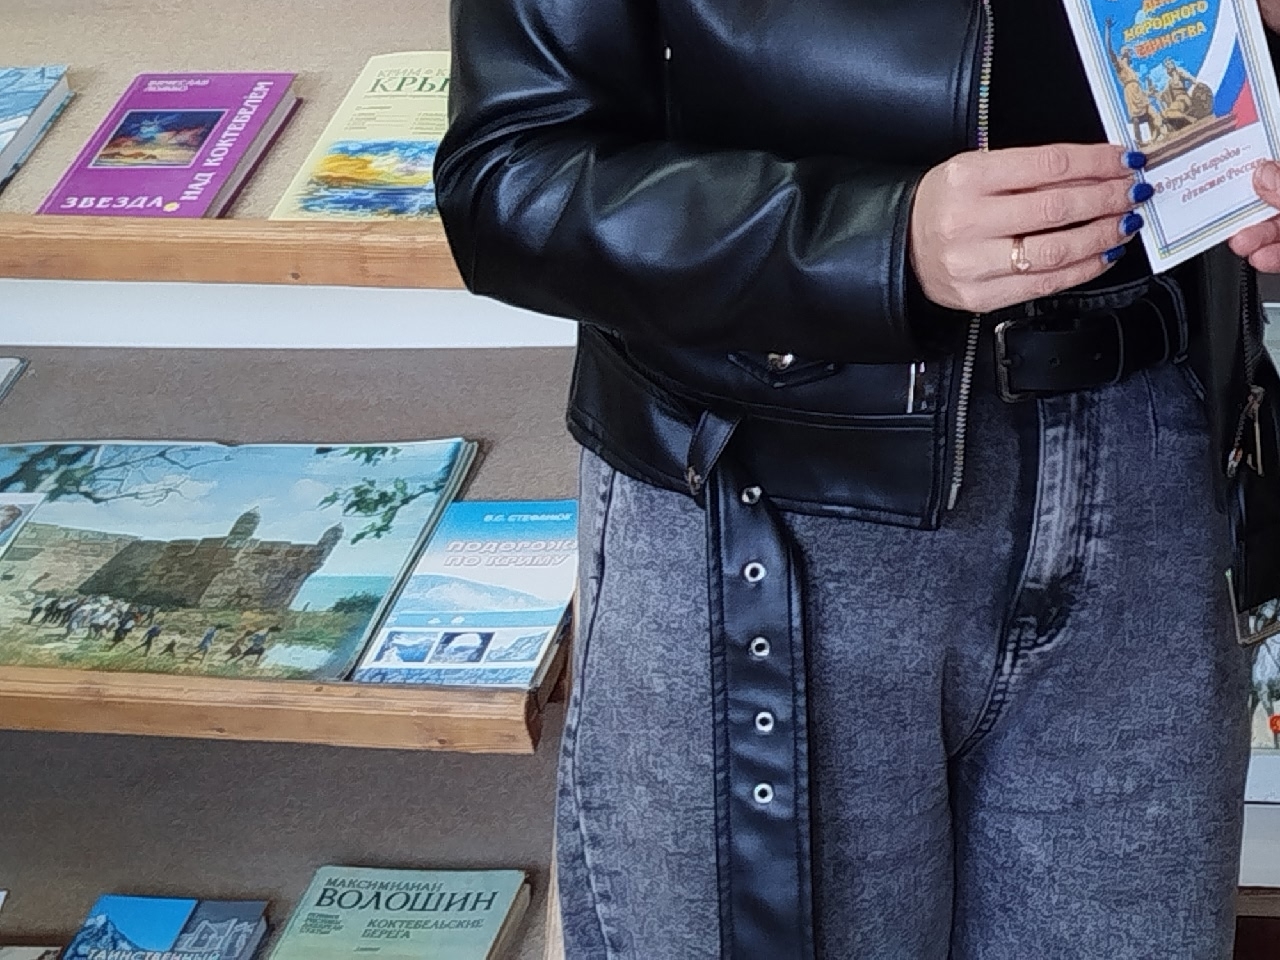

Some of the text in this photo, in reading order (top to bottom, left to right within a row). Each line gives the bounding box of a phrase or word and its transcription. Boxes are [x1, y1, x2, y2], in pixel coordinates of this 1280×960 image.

[1123, 0, 1208, 42] НАРОДНОГО
[367, 76, 450, 93] КРЫ
[180, 172, 216, 201] НАД
[60, 196, 165, 209] ЗВЕЗДА
[443, 555, 571, 567] ПО КРИМУ
[325, 877, 444, 892] МАКСИМИЛИАН
[314, 887, 499, 913] ВОЛОШИН
[367, 918, 486, 930] КОКТЕБЕЛЬСКИЕ
[361, 929, 412, 939] БЕРЕГА
